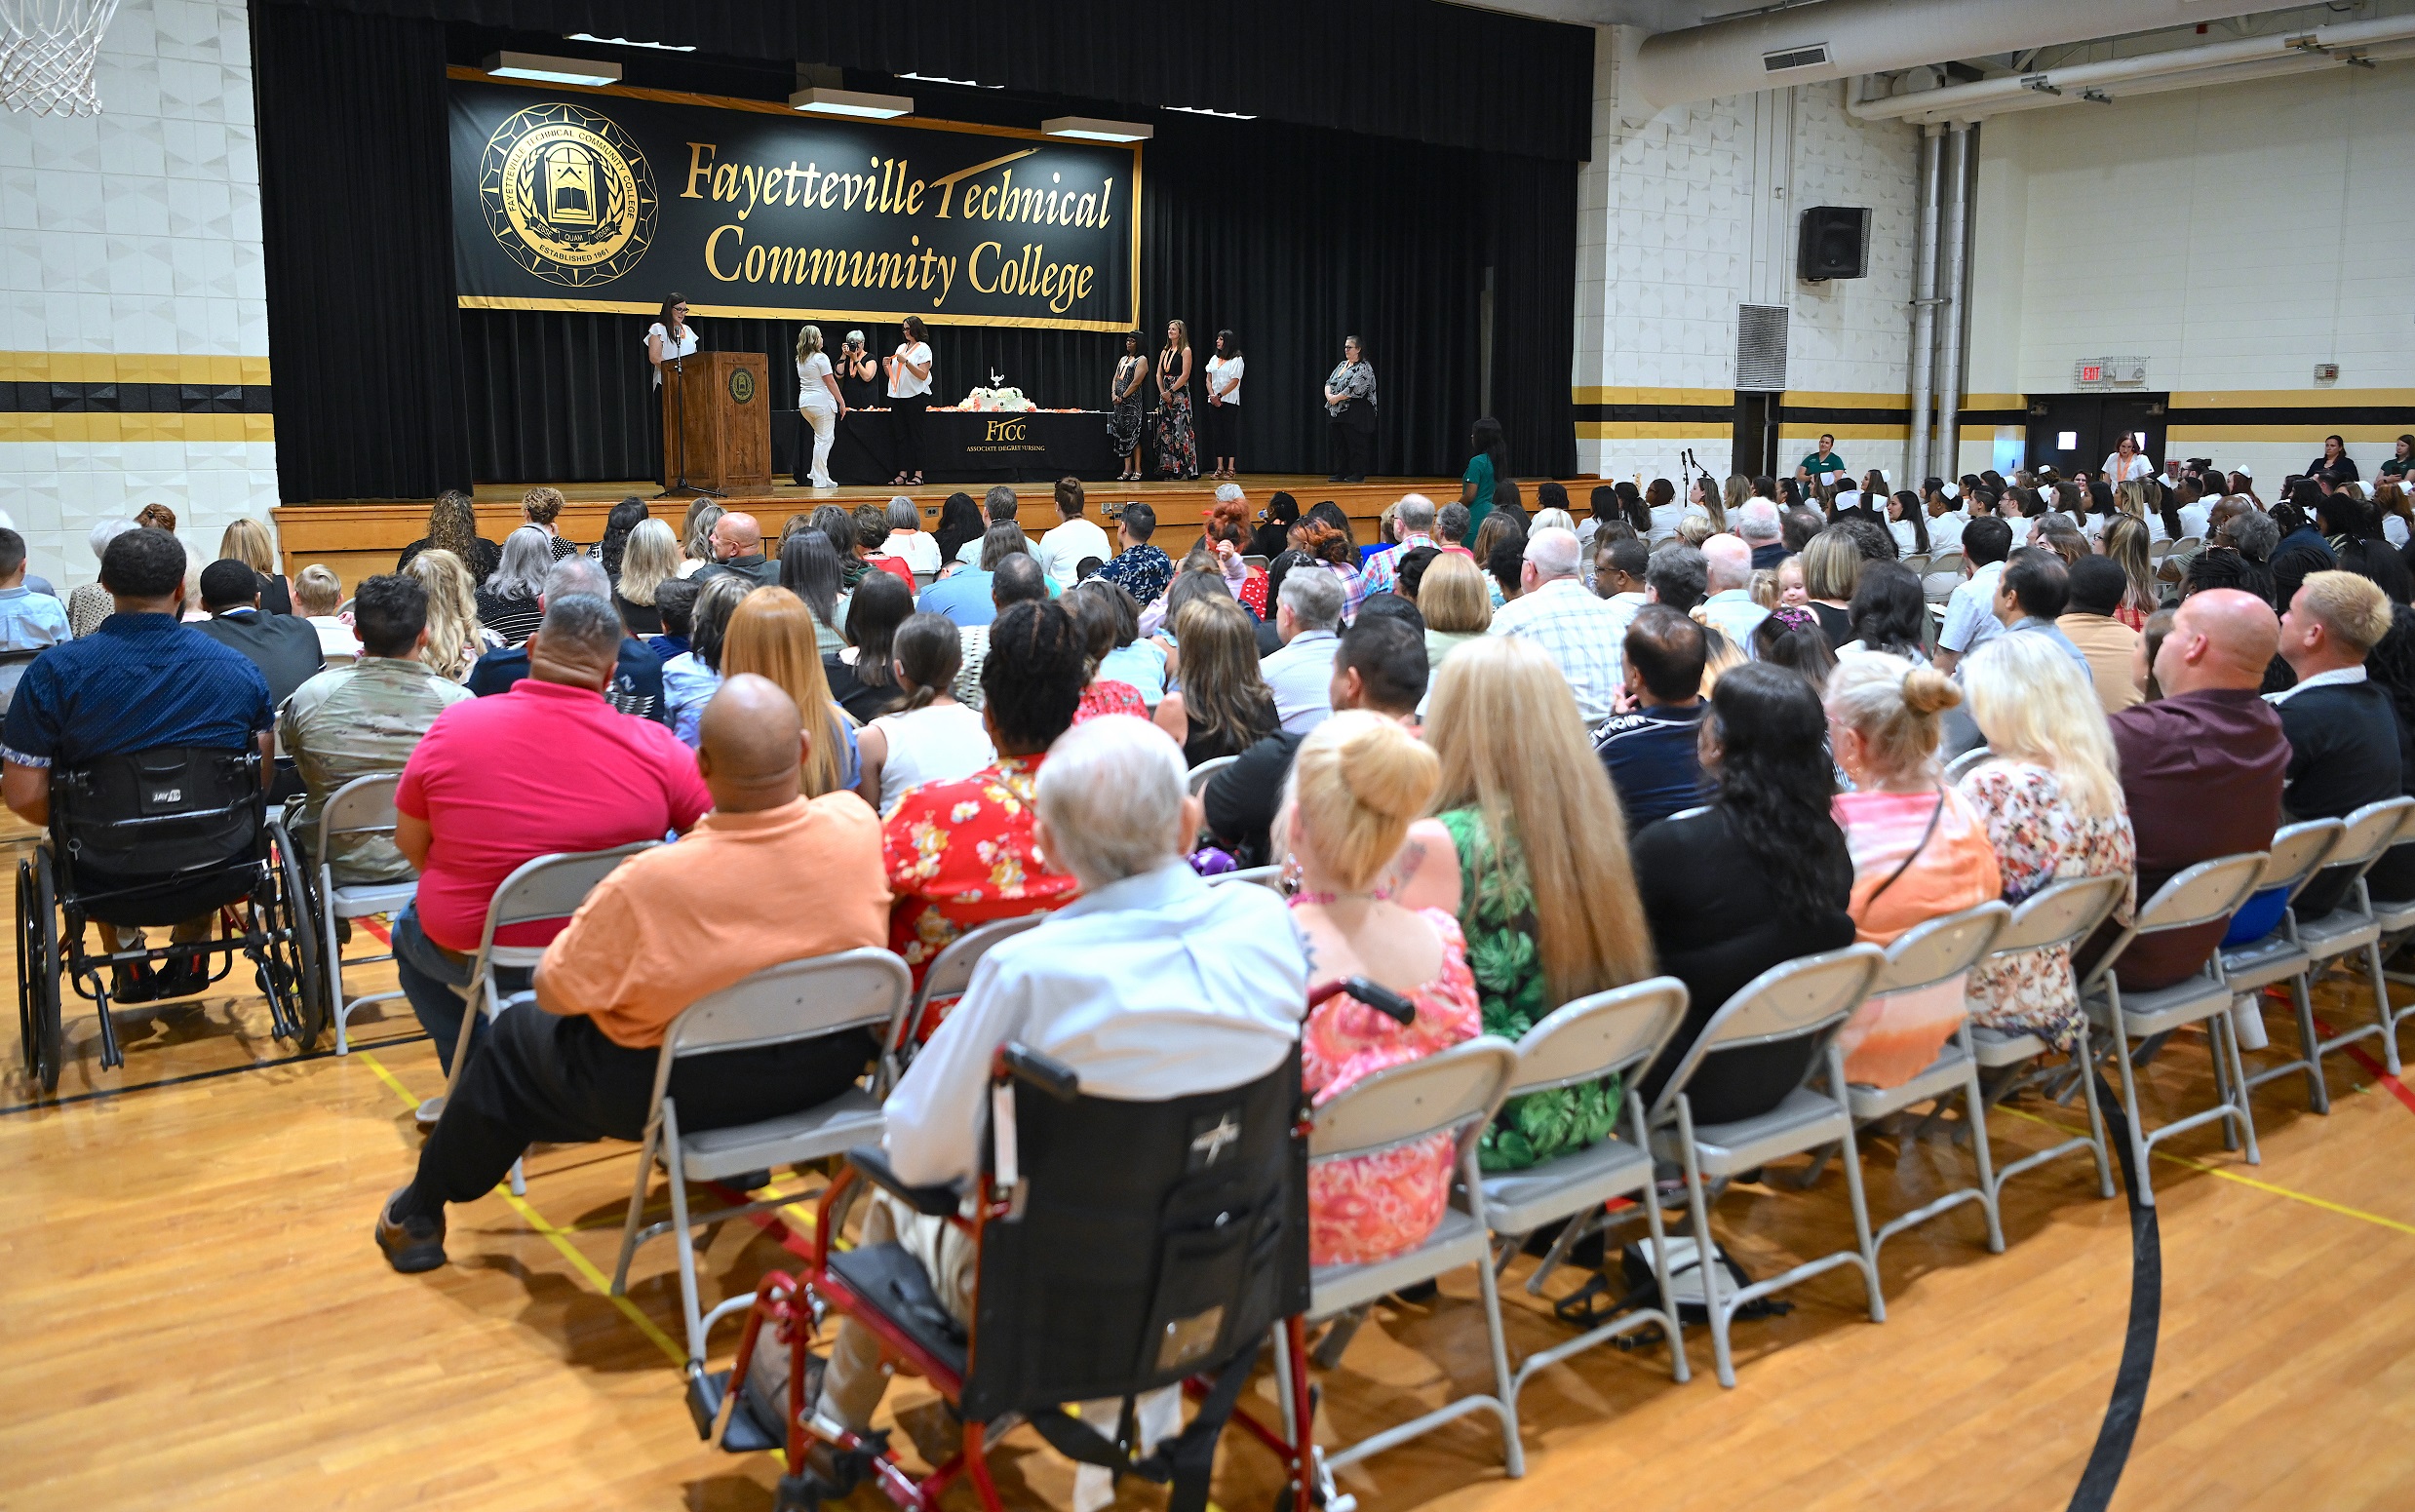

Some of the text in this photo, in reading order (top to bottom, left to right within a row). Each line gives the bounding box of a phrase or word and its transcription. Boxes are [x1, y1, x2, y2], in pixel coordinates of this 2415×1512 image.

[505, 129, 636, 219] FAYETTEVILLE TECHNICAL COMMUNITY COLLEGE
[680, 141, 1113, 230] Fayetteville Technical
[536, 222, 554, 238] ESSE
[564, 233, 584, 242] QUAM
[539, 244, 610, 262] ESTABLISHED 1961
[704, 224, 1094, 314] Community College
[2084, 367, 2100, 381] EXIT
[985, 416, 1027, 442] FTCC
